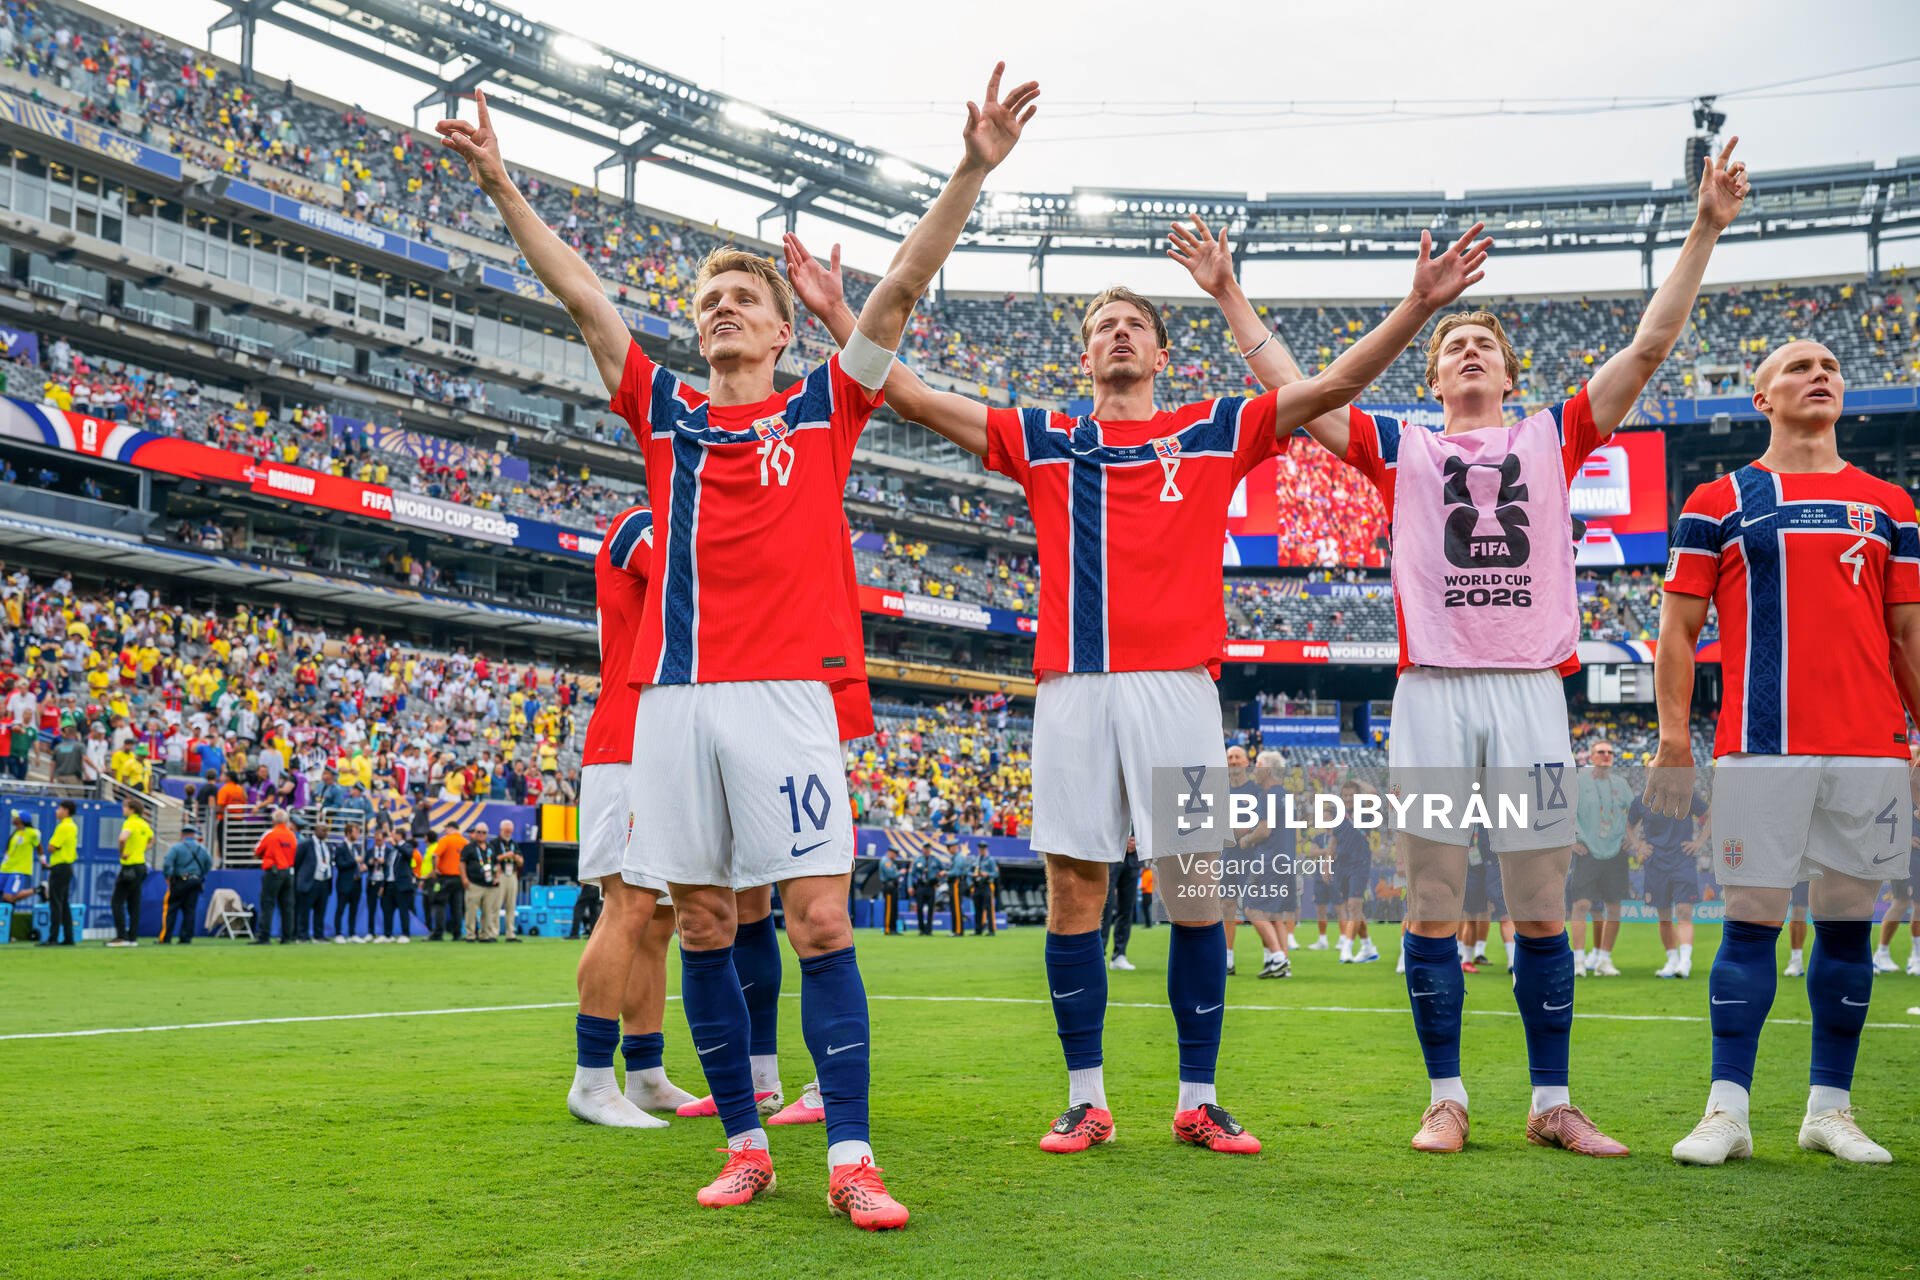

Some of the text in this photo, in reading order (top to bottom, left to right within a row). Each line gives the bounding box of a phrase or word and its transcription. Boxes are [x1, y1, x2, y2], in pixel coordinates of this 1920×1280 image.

[756, 440, 795, 487] 10
[1160, 457, 1184, 503] 8
[362, 490, 520, 540] FIFA WORLD CUP 2026
[1469, 541, 1511, 558] FIFA
[1840, 537, 1868, 585] 4
[1331, 584, 1359, 598] FIFA
[1443, 573, 1532, 587] WORLD CUP
[1444, 588, 1532, 608] 2026
[1303, 645, 1329, 658] FIFA
[1329, 646, 1374, 658] WORLD
[780, 774, 832, 834] 10
[1182, 765, 1209, 814] 8
[1528, 762, 1568, 811] 18
[1875, 797, 1898, 844] 4
